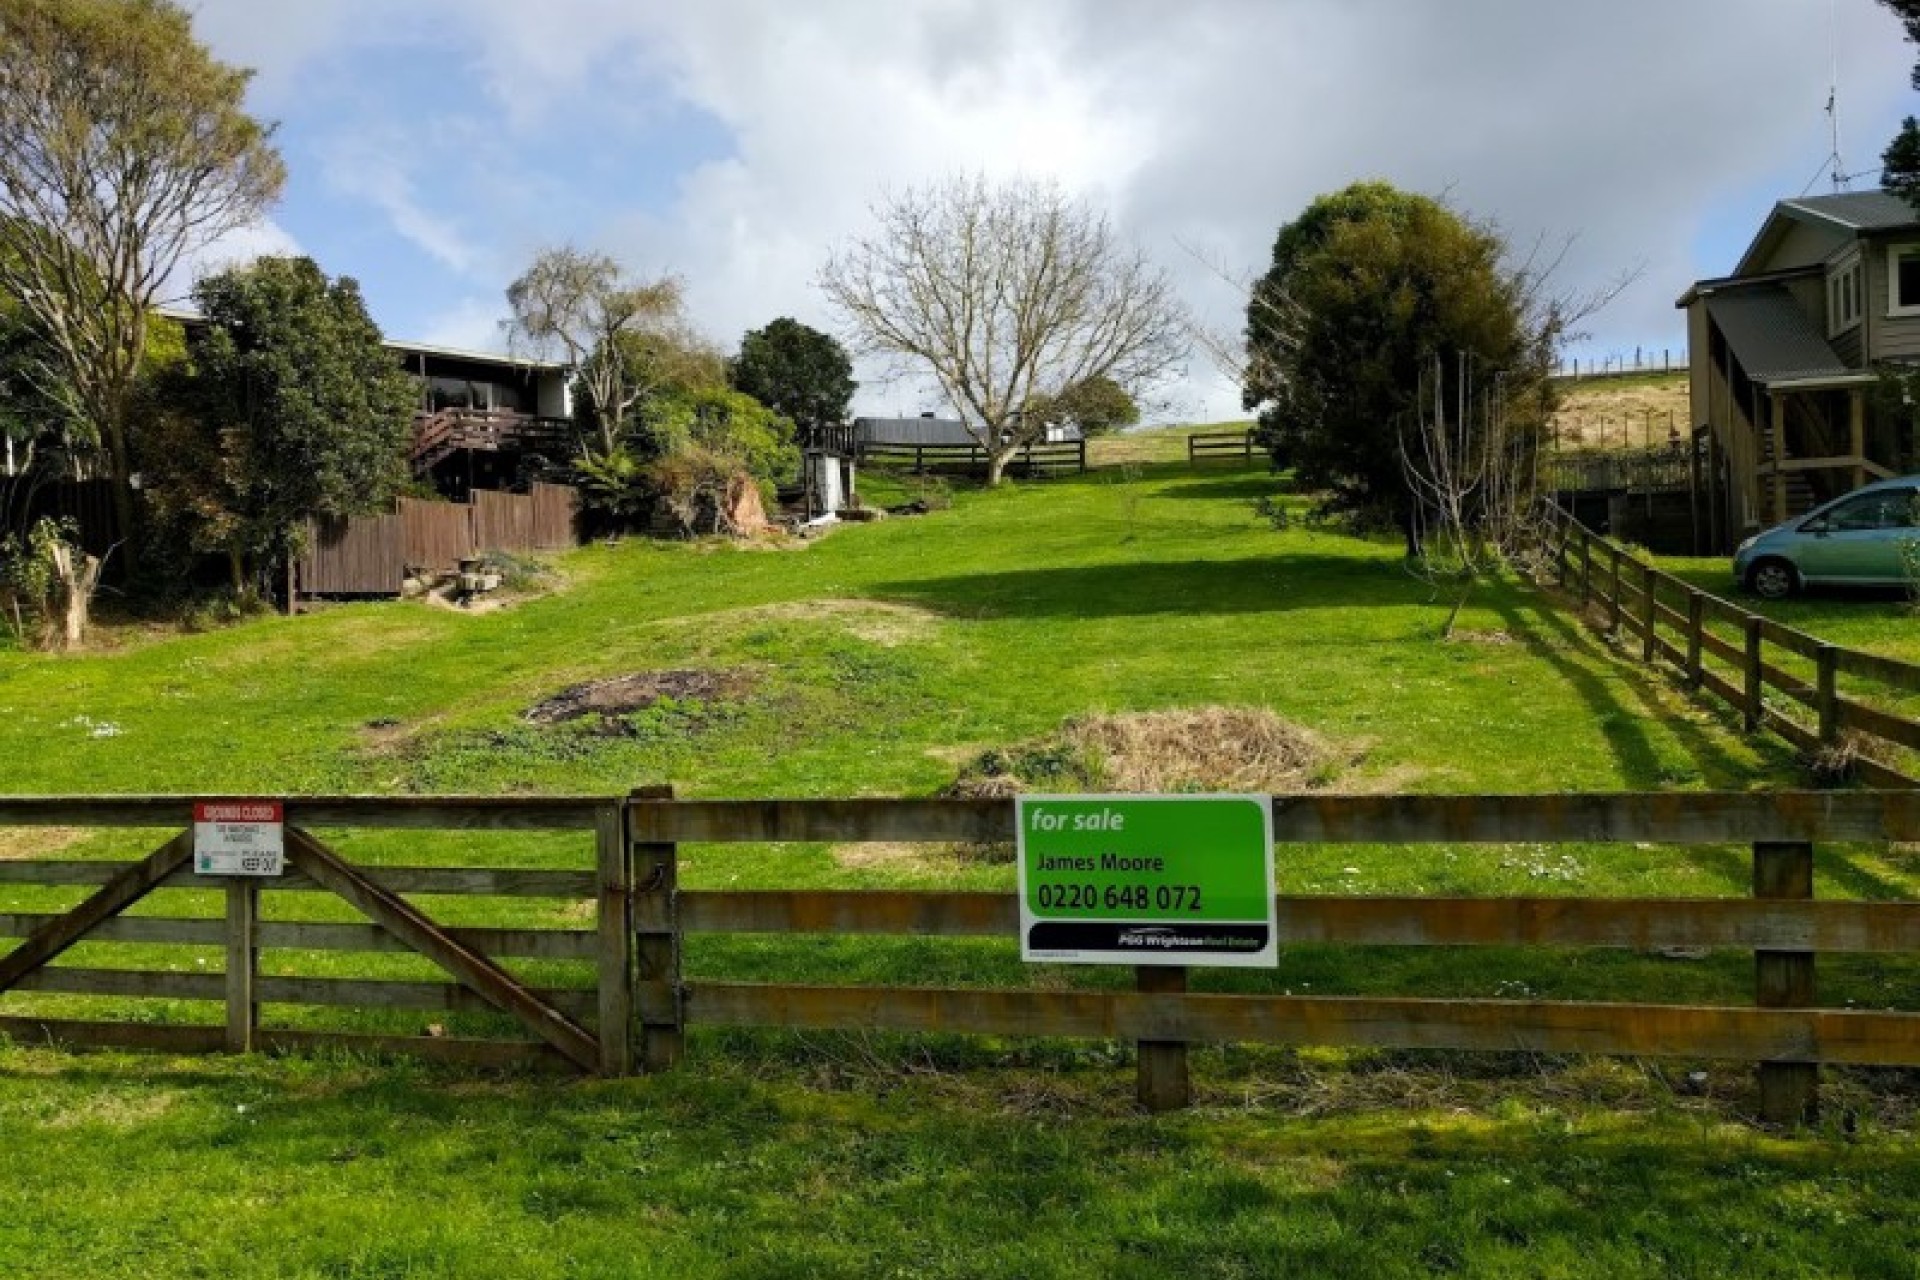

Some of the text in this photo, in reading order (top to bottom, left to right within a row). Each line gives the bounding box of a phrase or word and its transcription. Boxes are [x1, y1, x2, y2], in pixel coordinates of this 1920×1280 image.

[1031, 808, 1124, 831] for sale
[1036, 853, 1164, 871] James Moore
[1038, 884, 1202, 911] 0220 648 072
